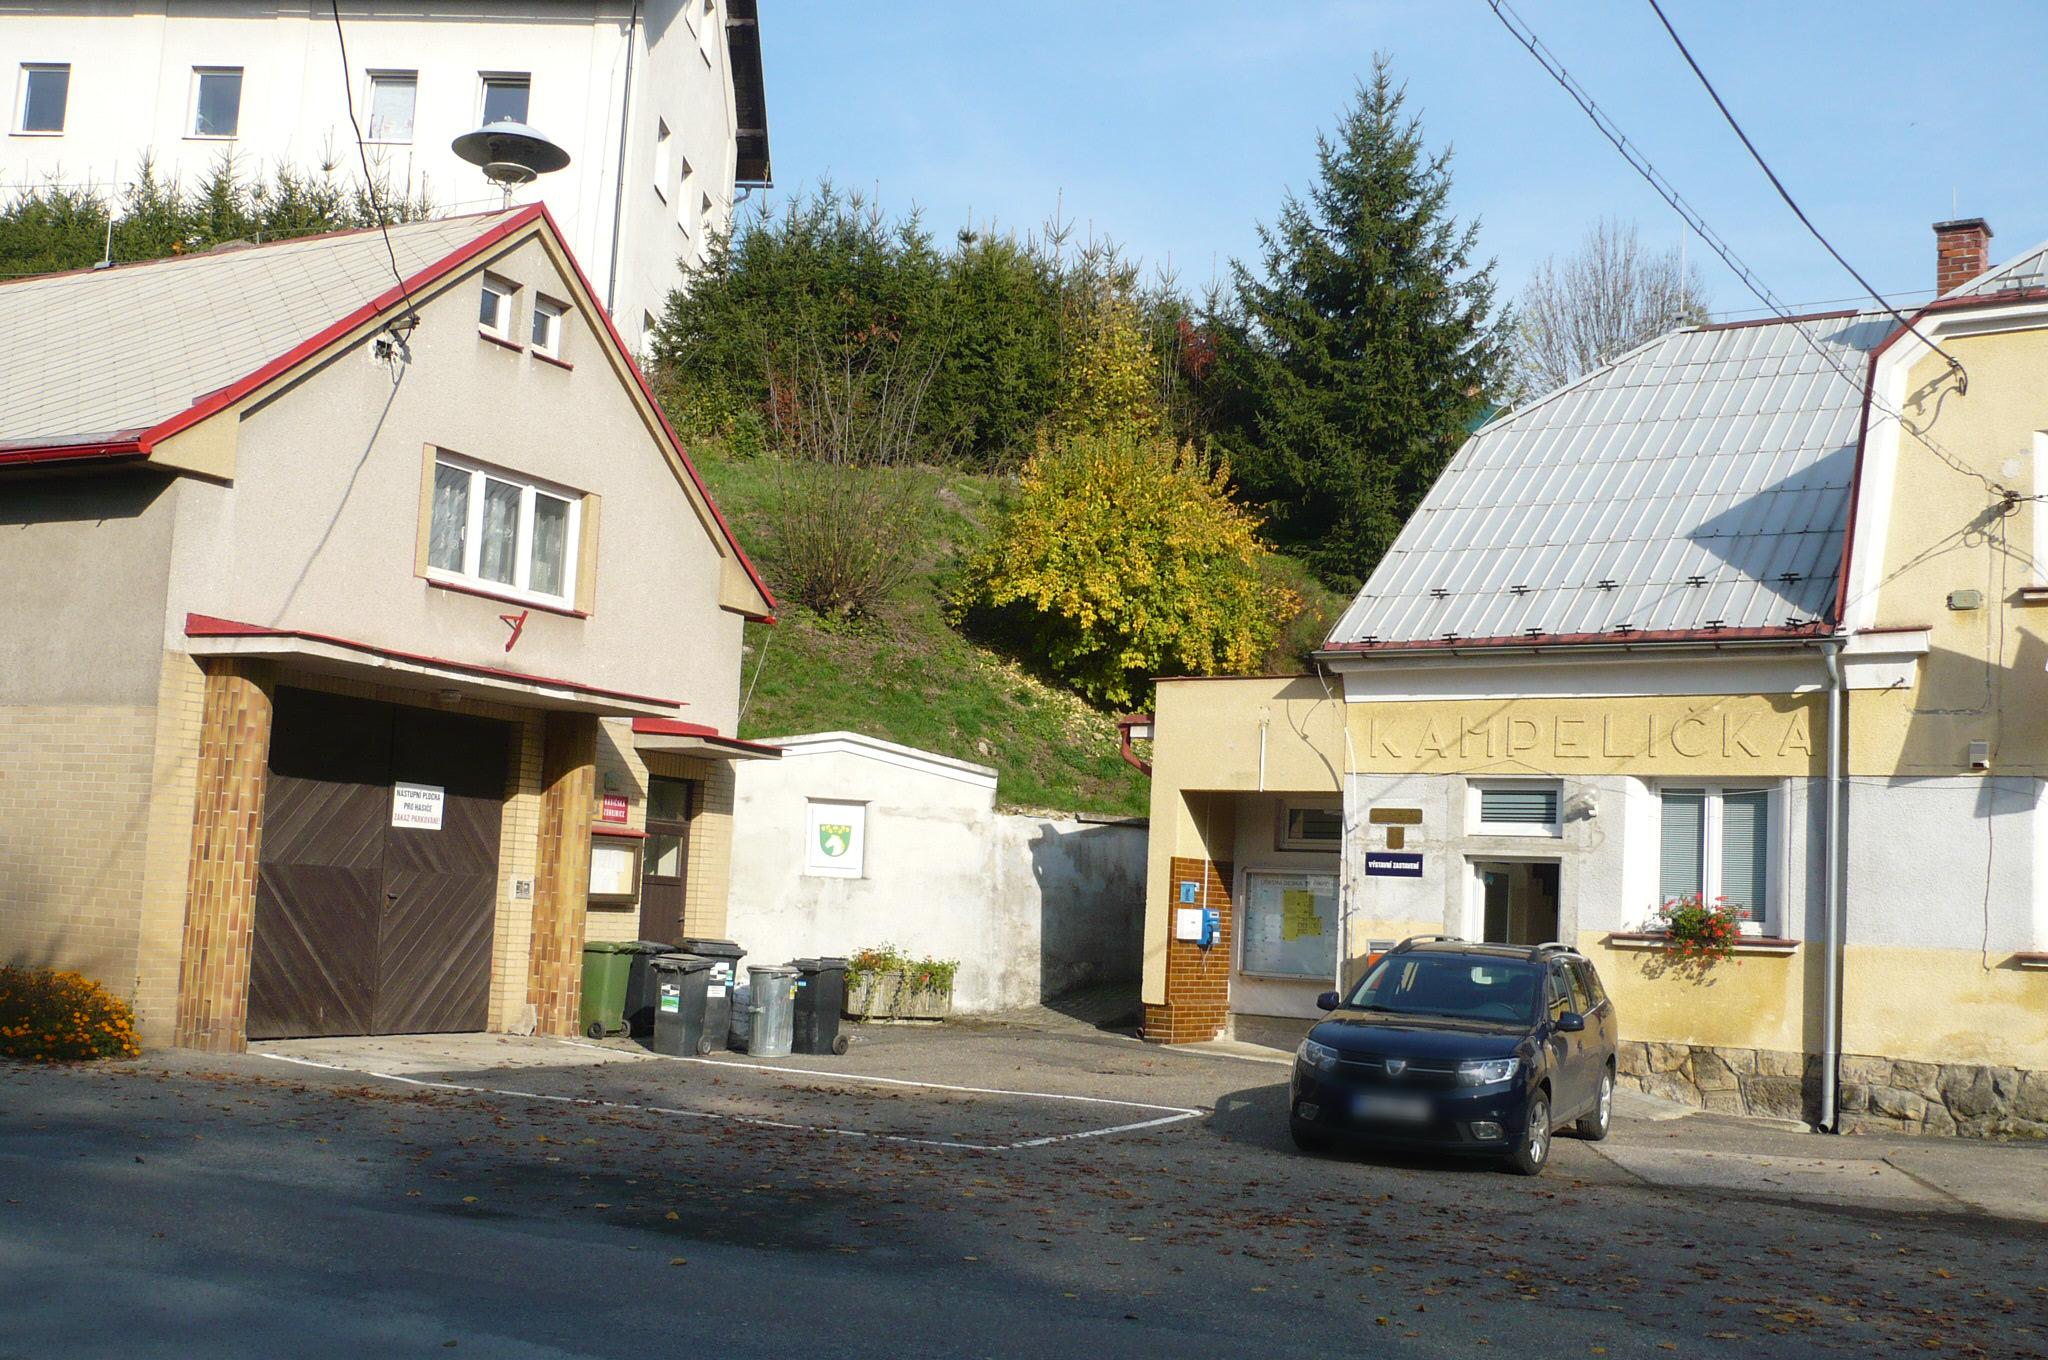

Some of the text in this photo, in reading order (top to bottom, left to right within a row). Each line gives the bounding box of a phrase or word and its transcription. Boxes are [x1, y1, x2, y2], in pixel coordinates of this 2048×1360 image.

[1369, 706, 1815, 759] KAMPELIČKA
[422, 791, 441, 801] PLOCHA
[403, 802, 414, 811] PRO
